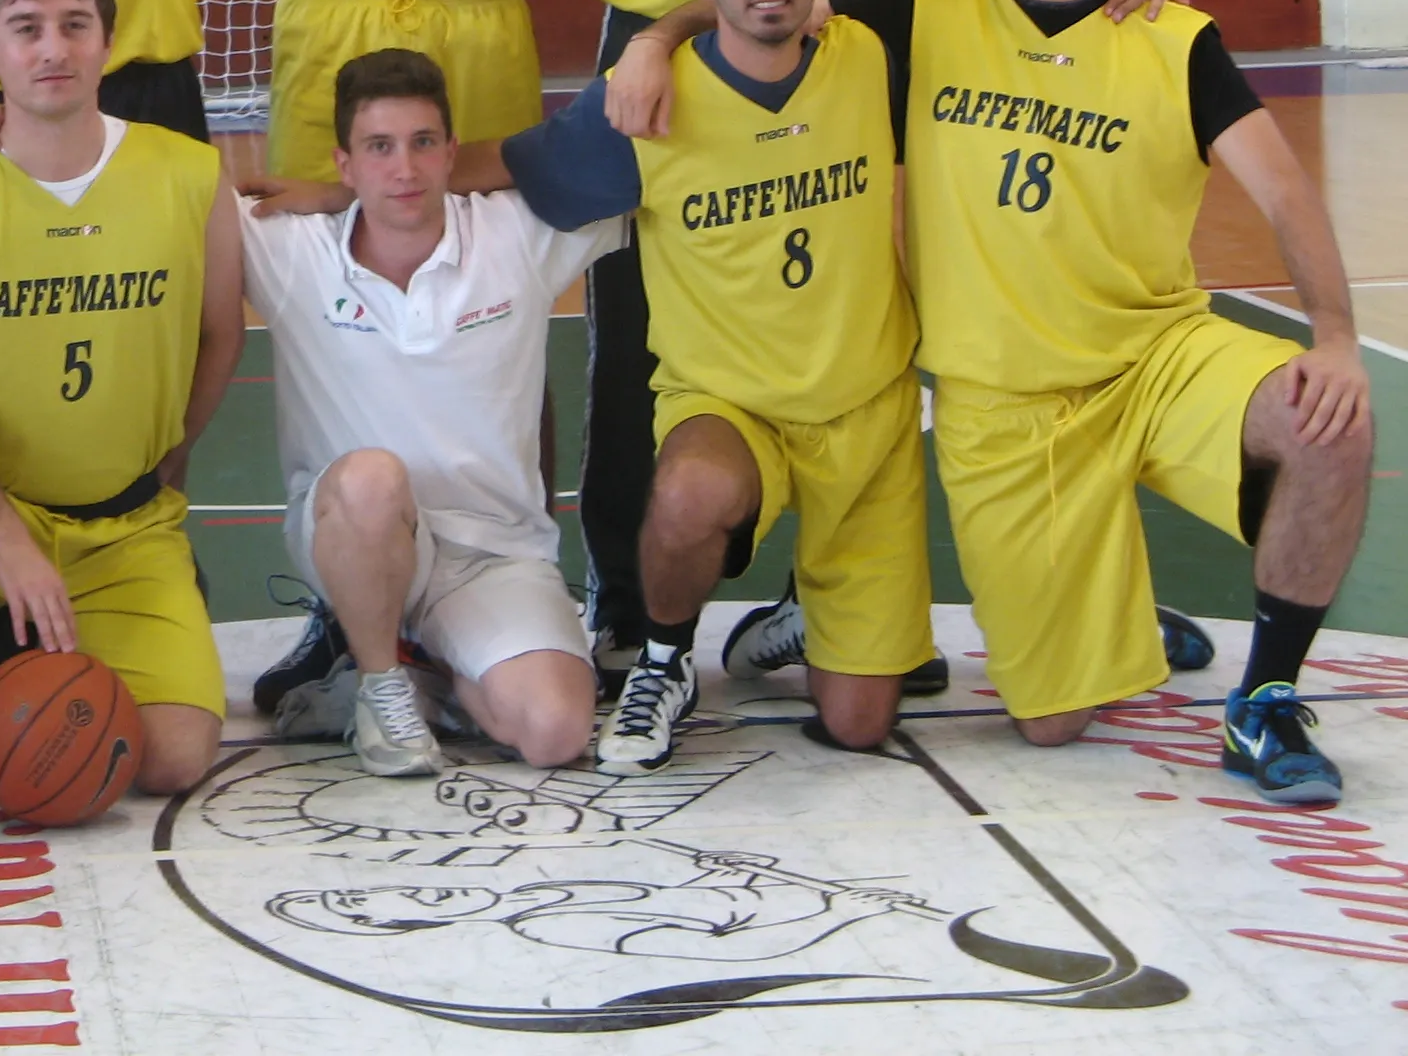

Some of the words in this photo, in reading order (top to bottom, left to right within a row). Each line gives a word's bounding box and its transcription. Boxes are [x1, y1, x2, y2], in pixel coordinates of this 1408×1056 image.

[1018, 49, 1075, 67] macron
[755, 123, 810, 143] macron
[932, 85, 1130, 155] CAFFE'MATIC
[682, 155, 868, 231] CAFFE'MATIC
[997, 148, 1055, 213] 18
[46, 225, 102, 238] macron
[781, 227, 814, 289] 8
[60, 339, 93, 403] 5
